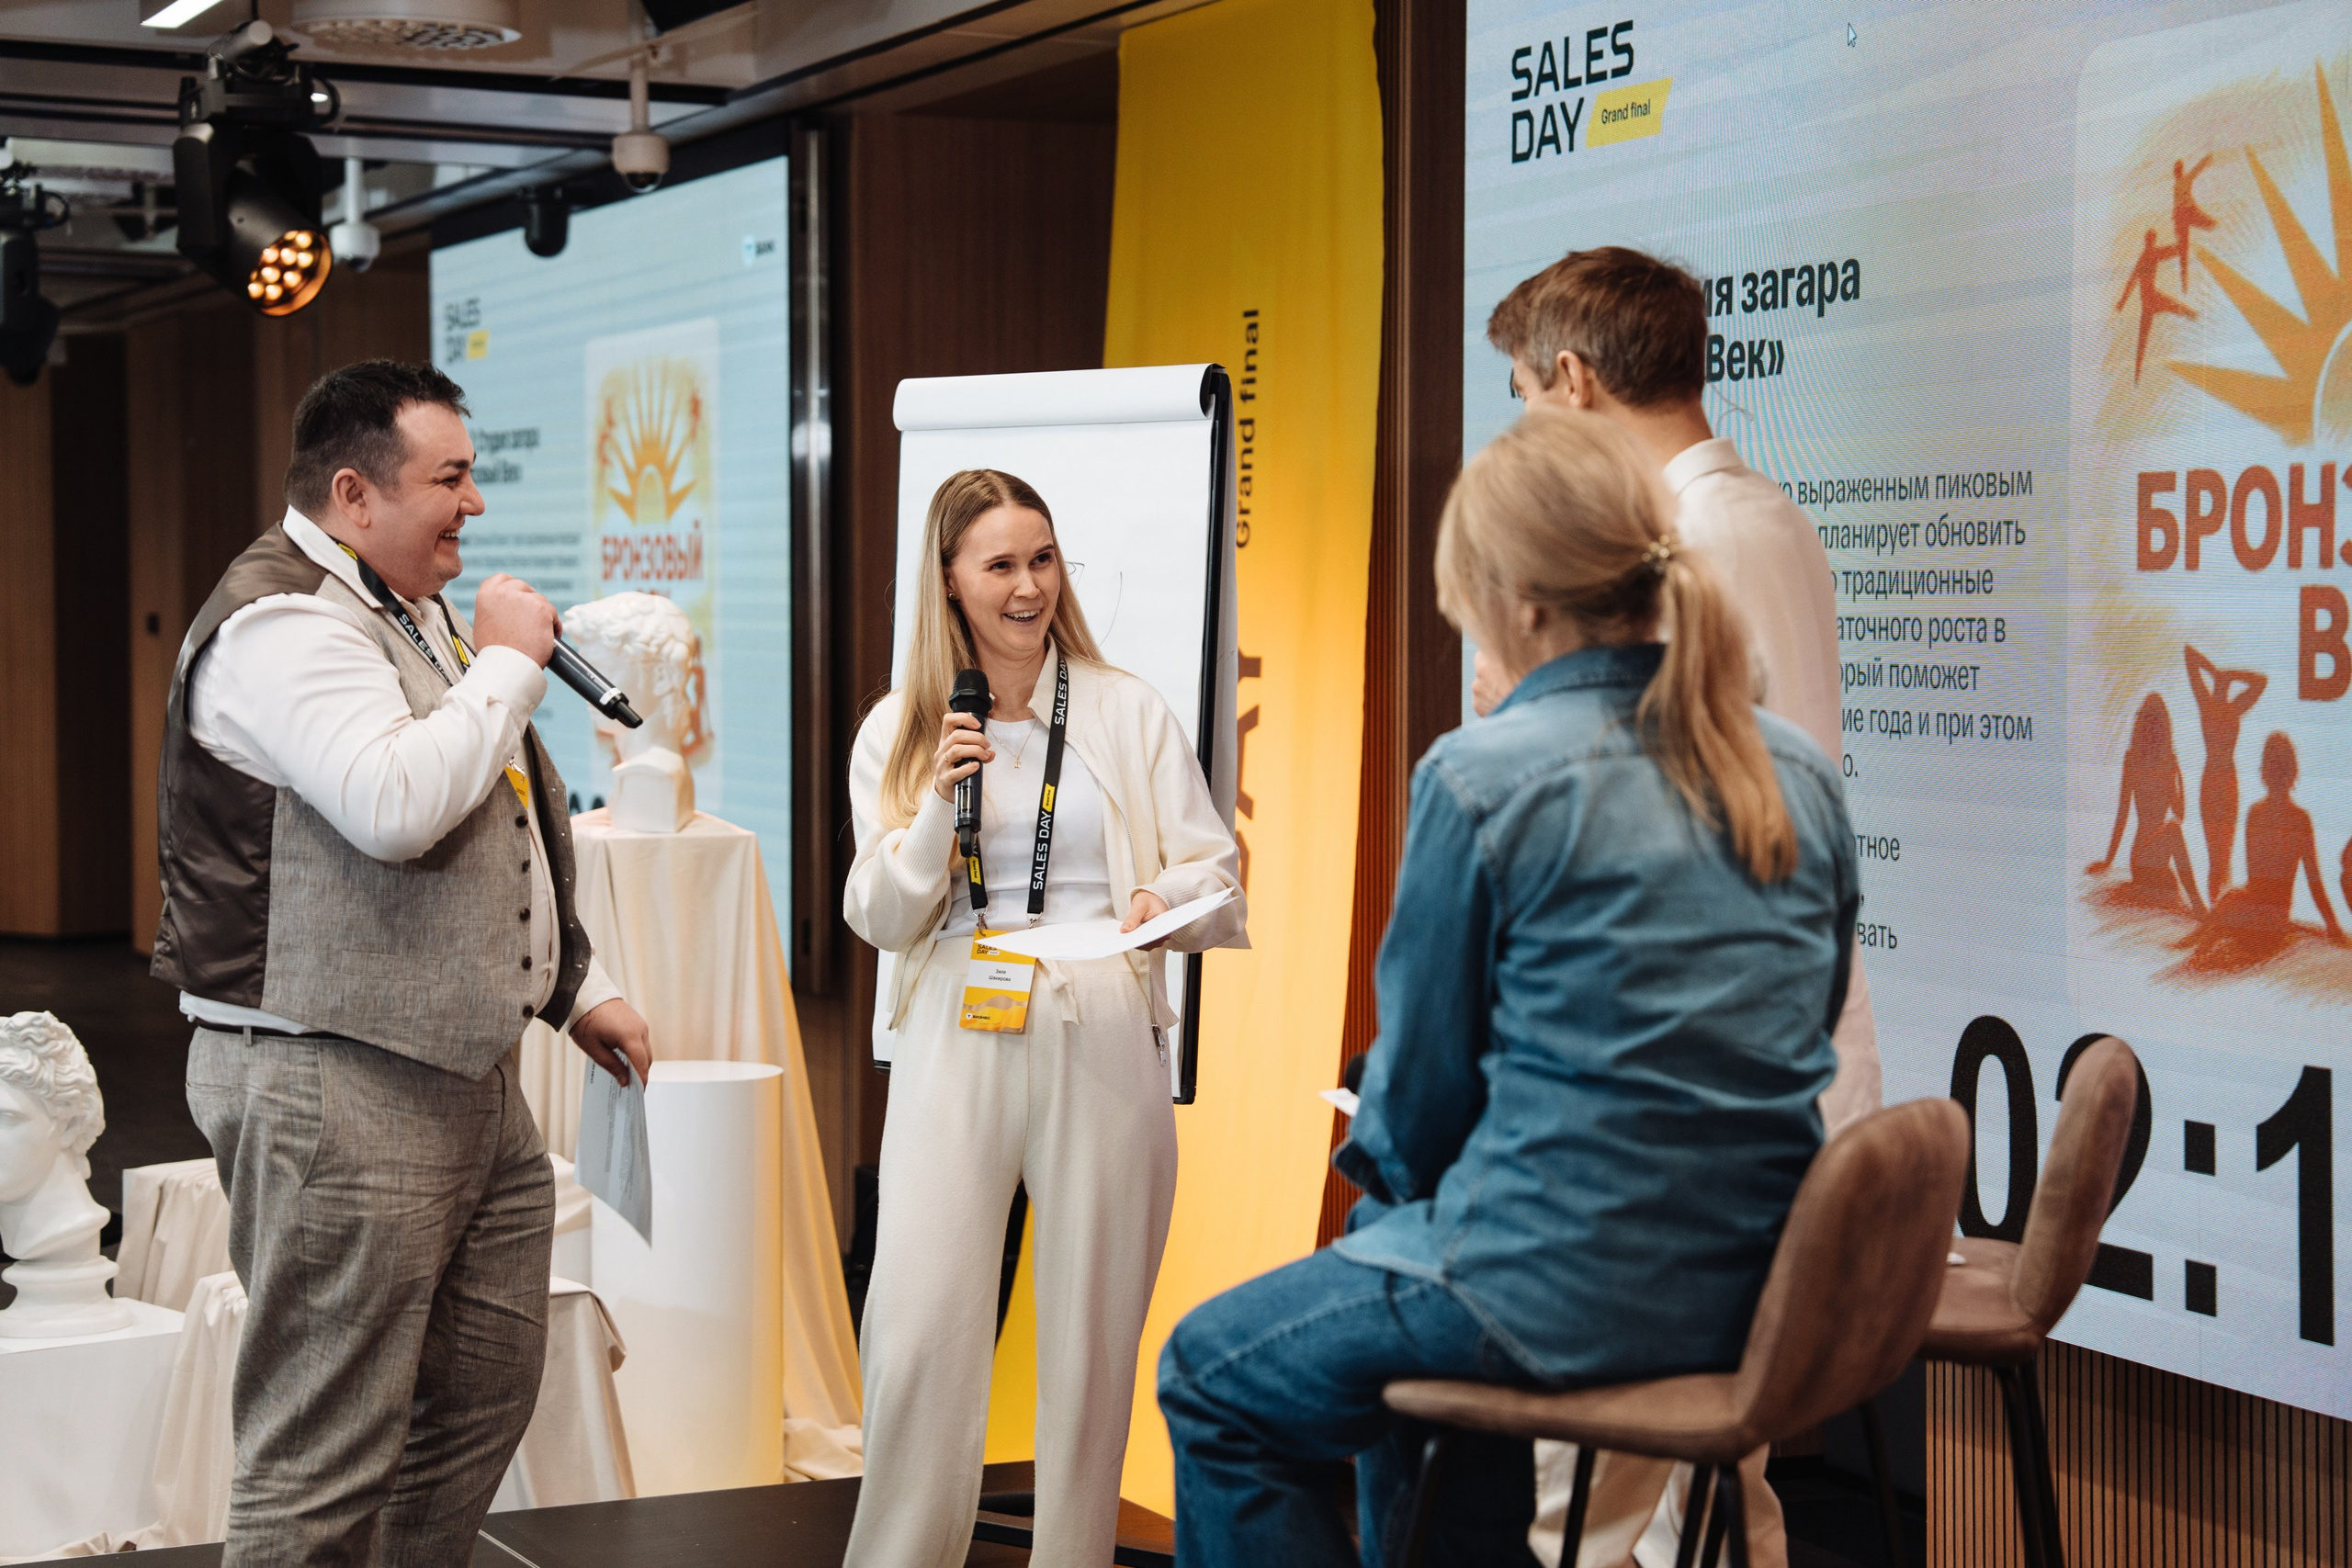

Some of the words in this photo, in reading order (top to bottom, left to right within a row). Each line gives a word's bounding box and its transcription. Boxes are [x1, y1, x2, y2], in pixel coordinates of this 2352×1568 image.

[1511, 19, 1634, 102] SALES
[1511, 96, 1584, 164] DAY
[1601, 104, 1629, 124] Grand
[1631, 98, 1651, 118] final
[1741, 258, 1860, 319] загара
[1240, 310, 1260, 404] final
[1705, 333, 1784, 383] Век»
[1236, 418, 1256, 548] Grand
[1798, 476, 1928, 512] выраженным
[1936, 470, 2032, 499] пиковым
[1818, 523, 1920, 556] планирует
[1926, 513, 2026, 547] обновить
[1842, 569, 1994, 603] традиционные
[399, 614, 435, 659] SALES
[1929, 616, 1987, 649] роста
[1995, 617, 2006, 642] в
[1890, 663, 1980, 691] поможет
[1054, 682, 1067, 726] SALES
[1871, 710, 1912, 739] года
[1919, 712, 1929, 736] и
[1937, 713, 1973, 745] при
[1980, 715, 2032, 740] этом
[1038, 810, 1052, 838] DAY
[1033, 843, 1048, 890] SALES
[1857, 922, 1898, 950] вать
